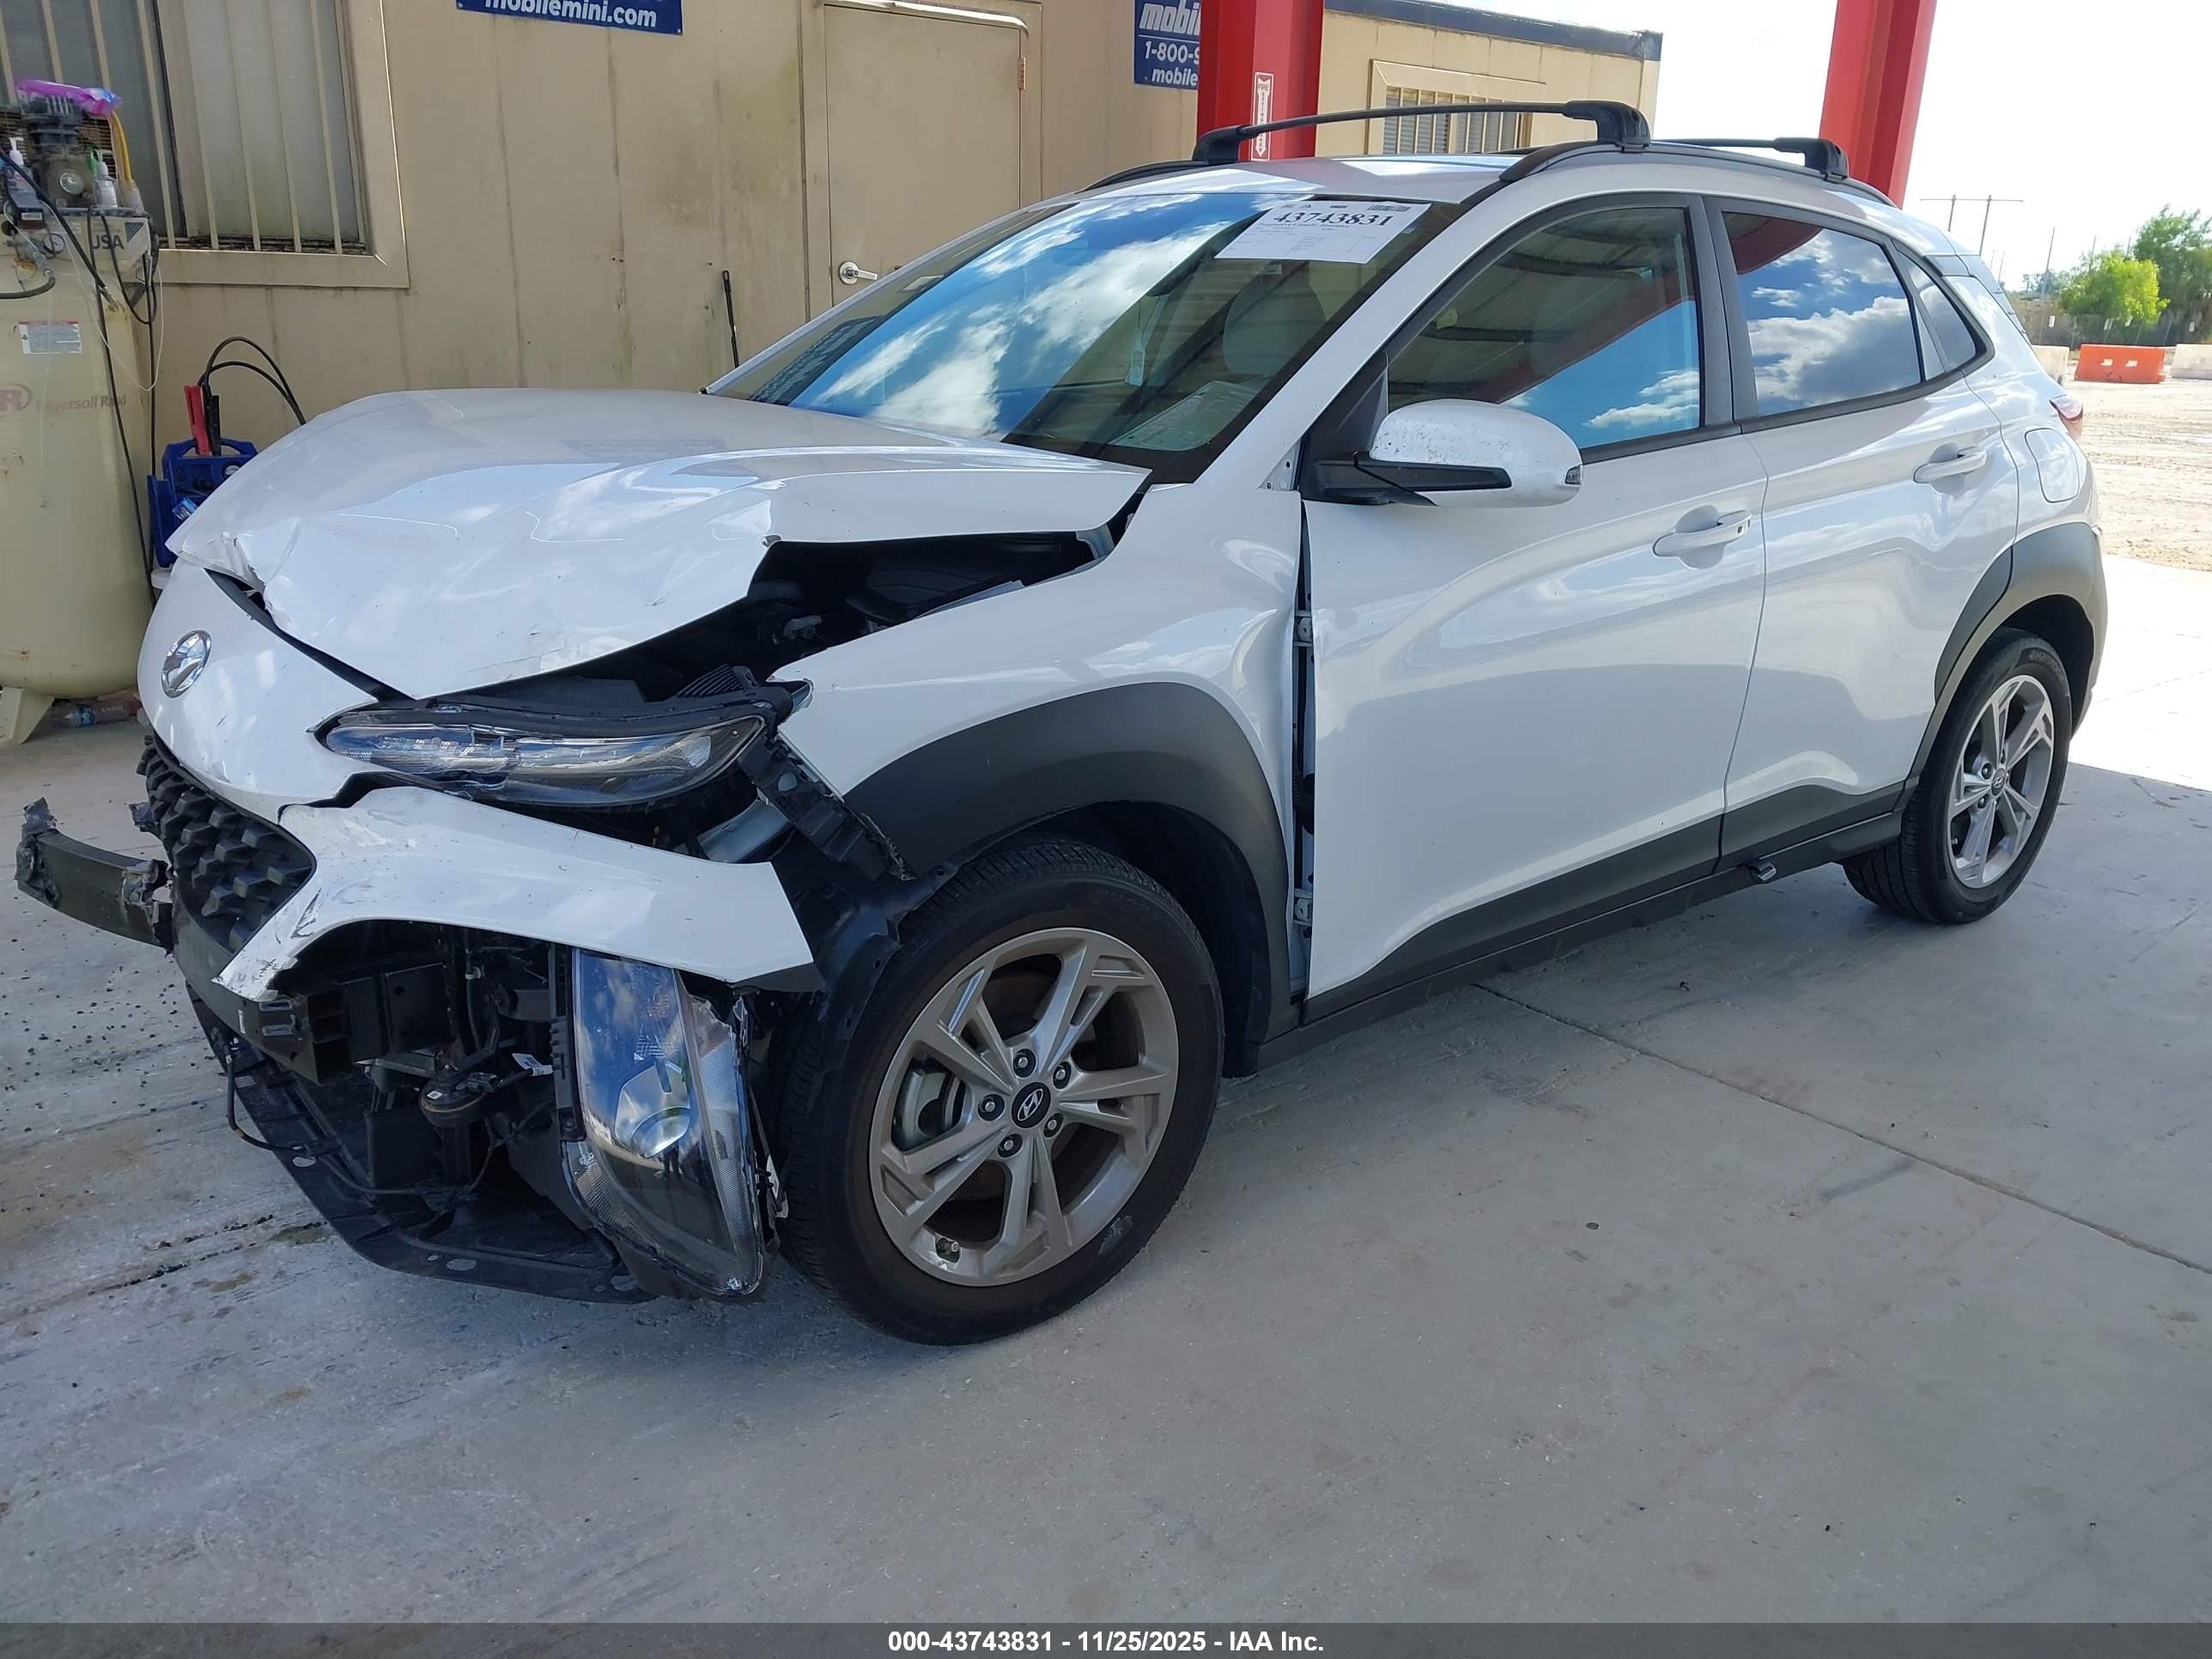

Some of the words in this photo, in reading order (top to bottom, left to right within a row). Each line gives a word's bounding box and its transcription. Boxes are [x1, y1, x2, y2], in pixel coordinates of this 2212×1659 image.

[485, 0, 656, 27] mobilemini.com
[1152, 67, 1199, 87] mobile
[1274, 212, 1393, 227] 43743831
[90, 234, 125, 250] USA
